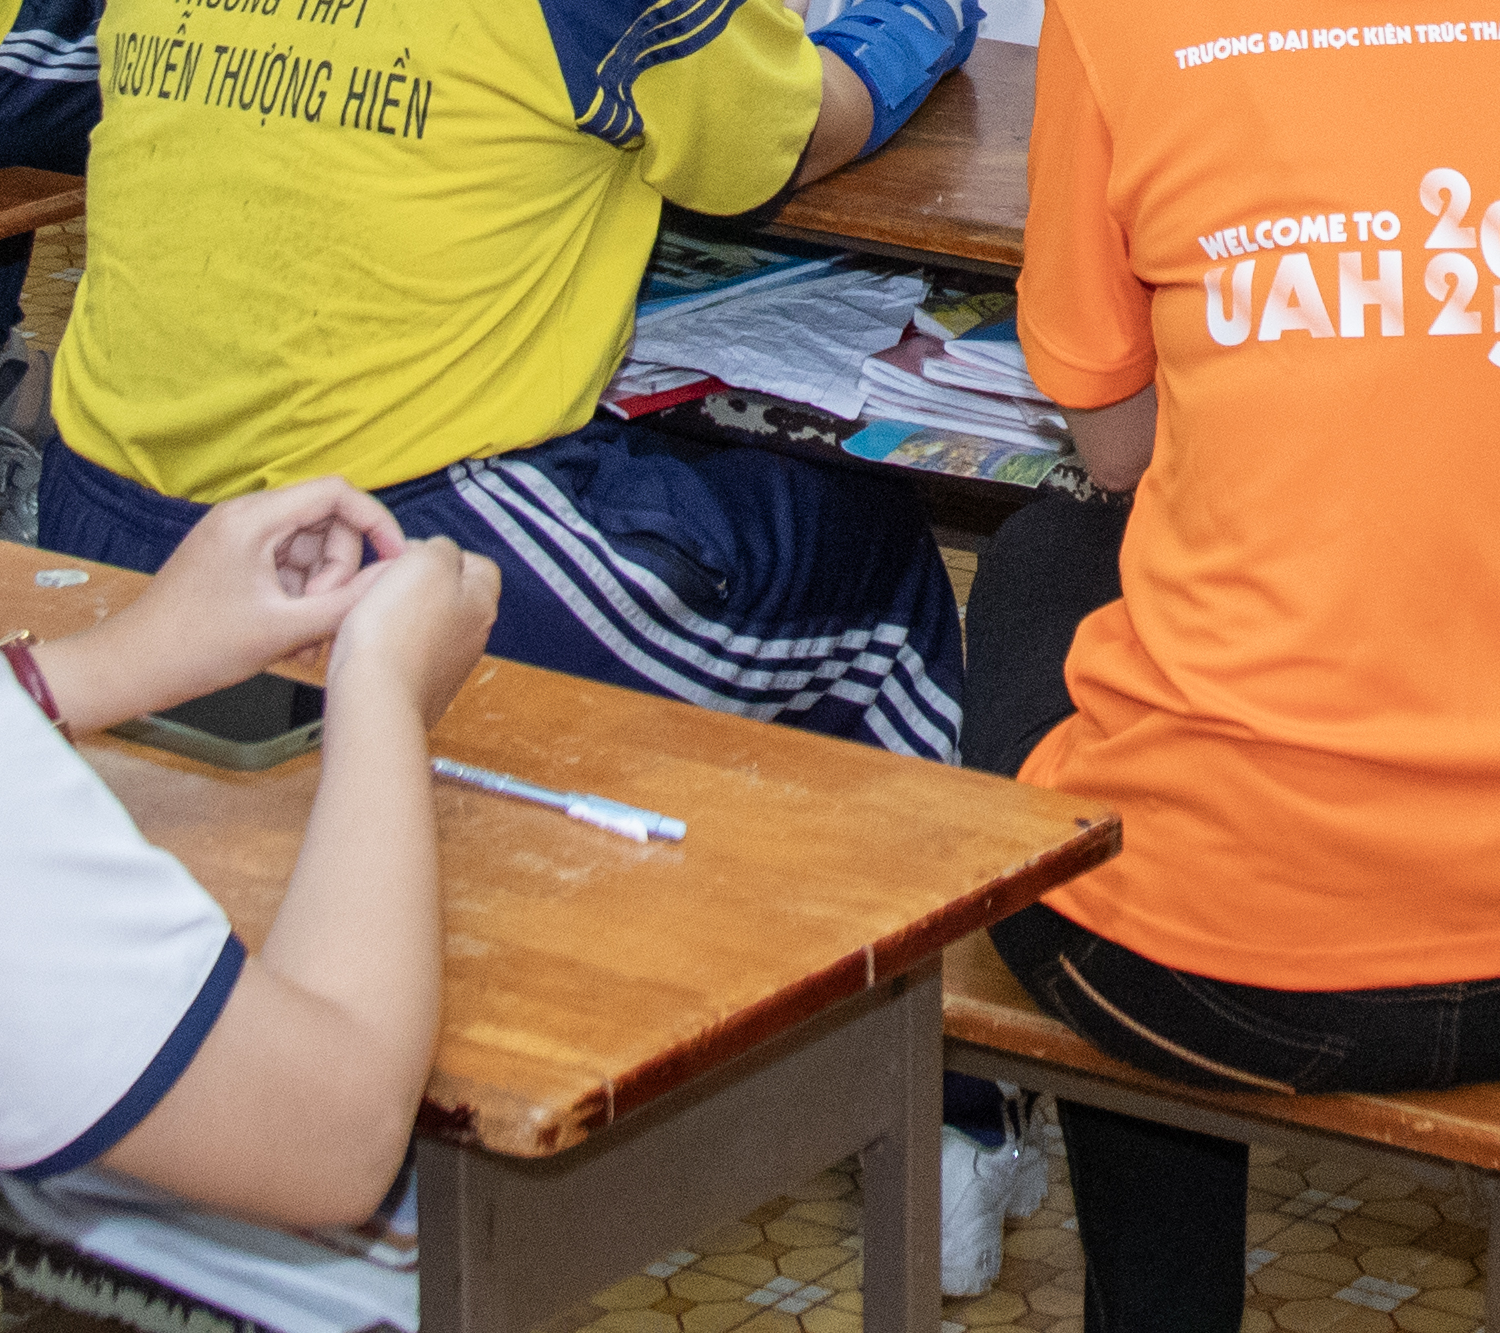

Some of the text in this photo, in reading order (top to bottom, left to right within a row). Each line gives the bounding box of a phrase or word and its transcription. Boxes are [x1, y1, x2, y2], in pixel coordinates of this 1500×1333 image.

[110, 9, 433, 140] NGUYỄN THƯỢNG HIỀN
[1173, 33, 1265, 70] TRƯỜNG
[1268, 28, 1309, 53] ĐẠI
[1312, 26, 1360, 50] HỌC
[1198, 210, 1401, 261] WELCOME TO
[1204, 249, 1405, 347] UAH
